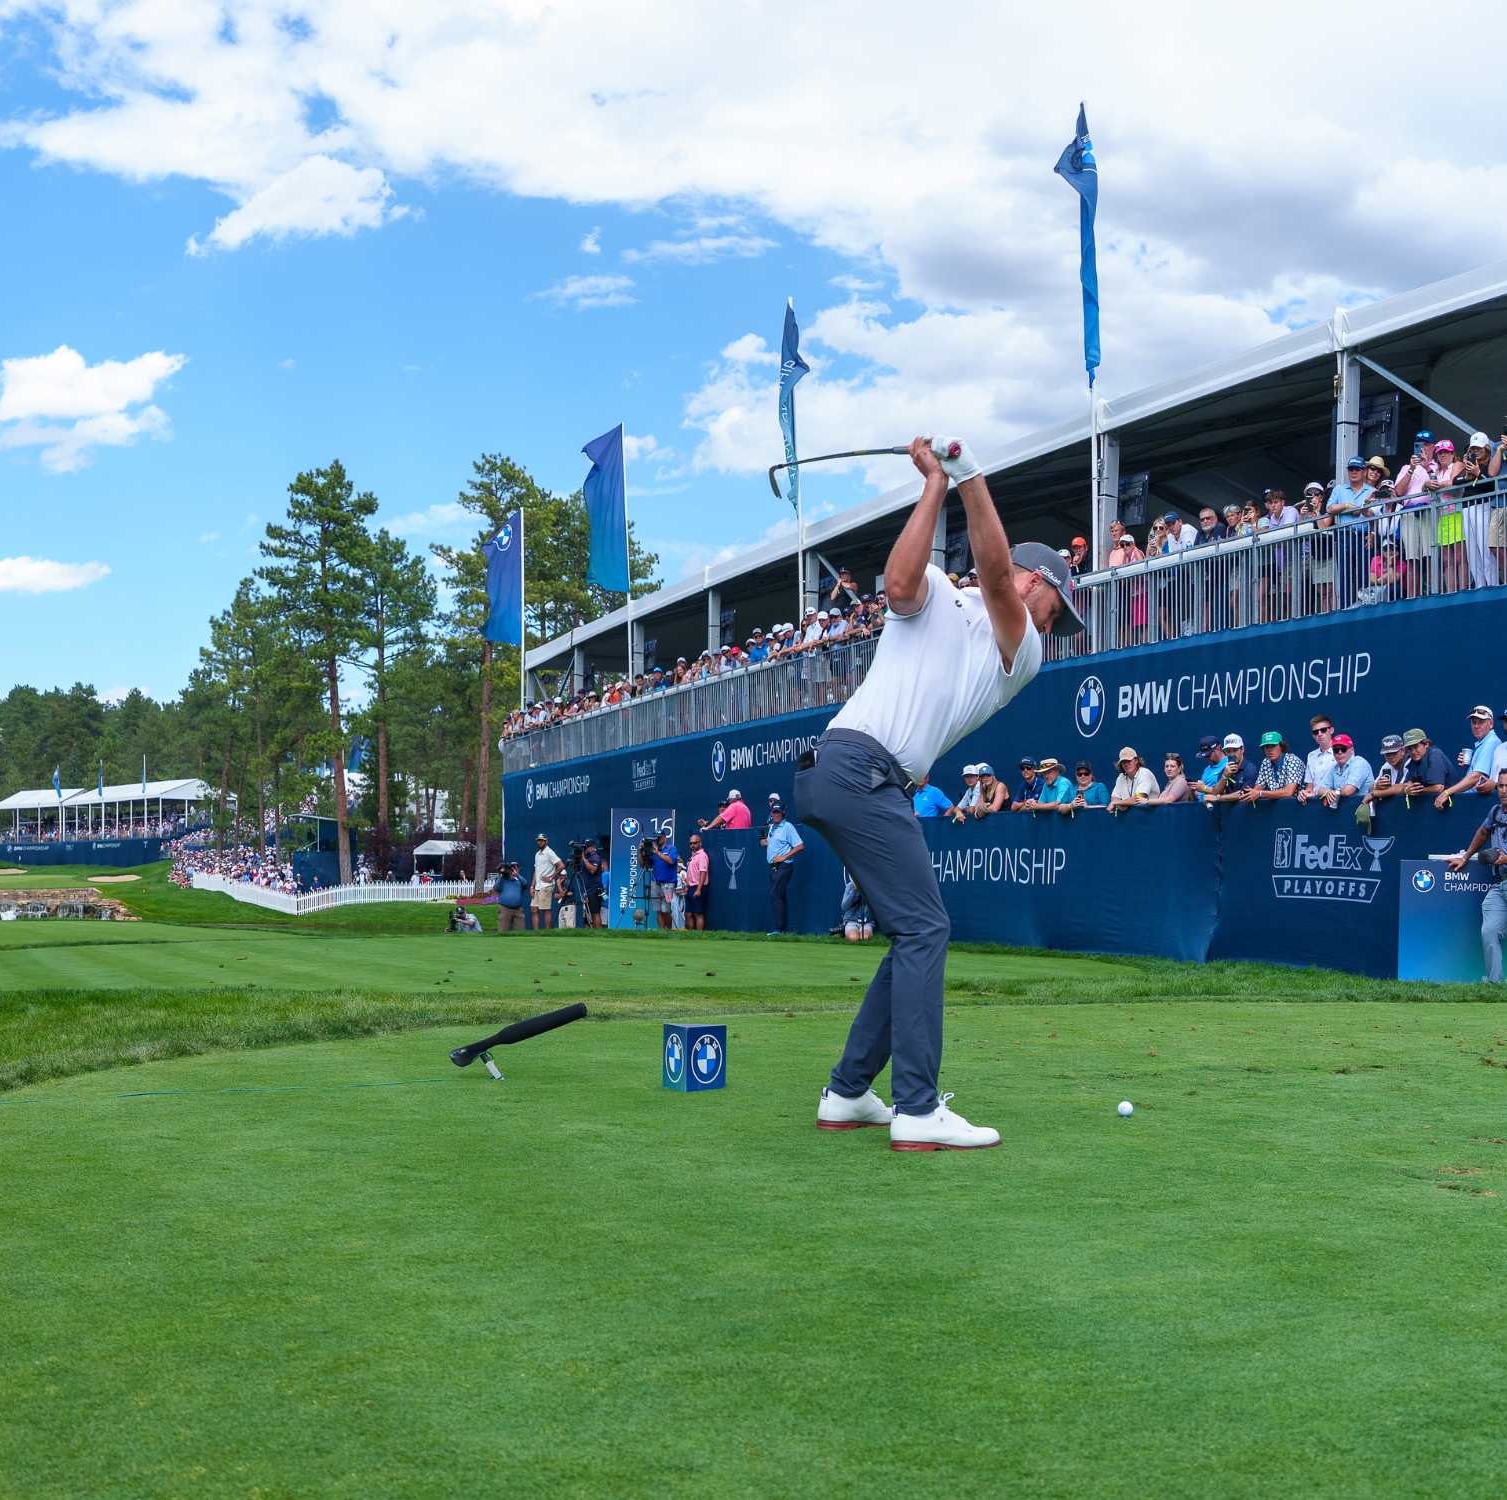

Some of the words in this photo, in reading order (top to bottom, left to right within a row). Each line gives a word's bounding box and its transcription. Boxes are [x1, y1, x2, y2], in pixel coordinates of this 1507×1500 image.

[1118, 679, 1173, 718] BMW
[1177, 652, 1371, 711] CHAMPIONSHIP
[731, 746, 754, 771] BMW
[755, 736, 819, 766] CHAMPIONS
[536, 784, 549, 800] BMW
[549, 776, 590, 799] CHAMPIONSHIP
[650, 818, 673, 839] 16
[1294, 834, 1362, 870] FedEx
[928, 847, 1066, 885] HAMPIONSHIP
[1444, 871, 1470, 881] BMW
[620, 886, 629, 908] BMW
[1283, 879, 1367, 898] PLAYOFFS
